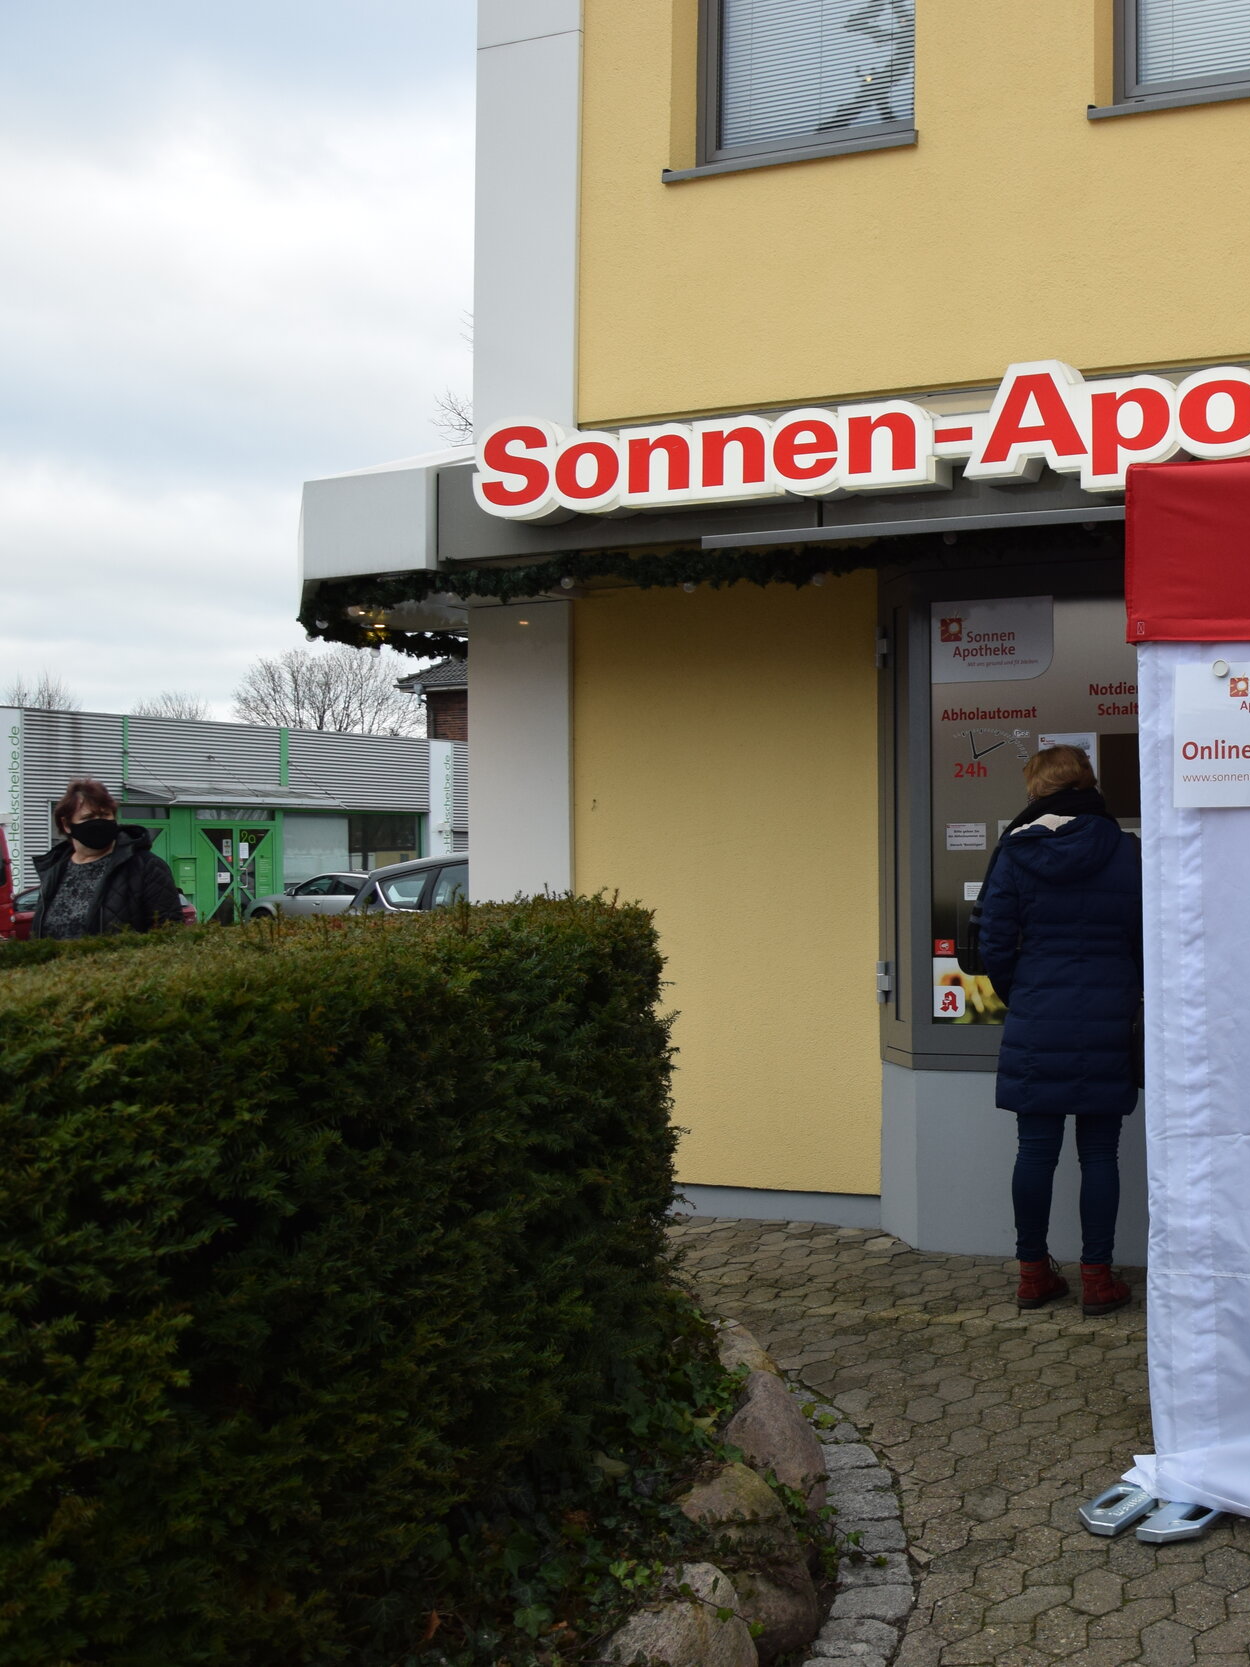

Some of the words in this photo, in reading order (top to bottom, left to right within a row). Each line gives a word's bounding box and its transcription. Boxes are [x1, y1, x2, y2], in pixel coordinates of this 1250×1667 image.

[966, 631, 1016, 643] Sonnen
[952, 643, 1016, 661] Apotheke
[941, 706, 1038, 722] Abholautomat
[953, 761, 988, 778] 24h
